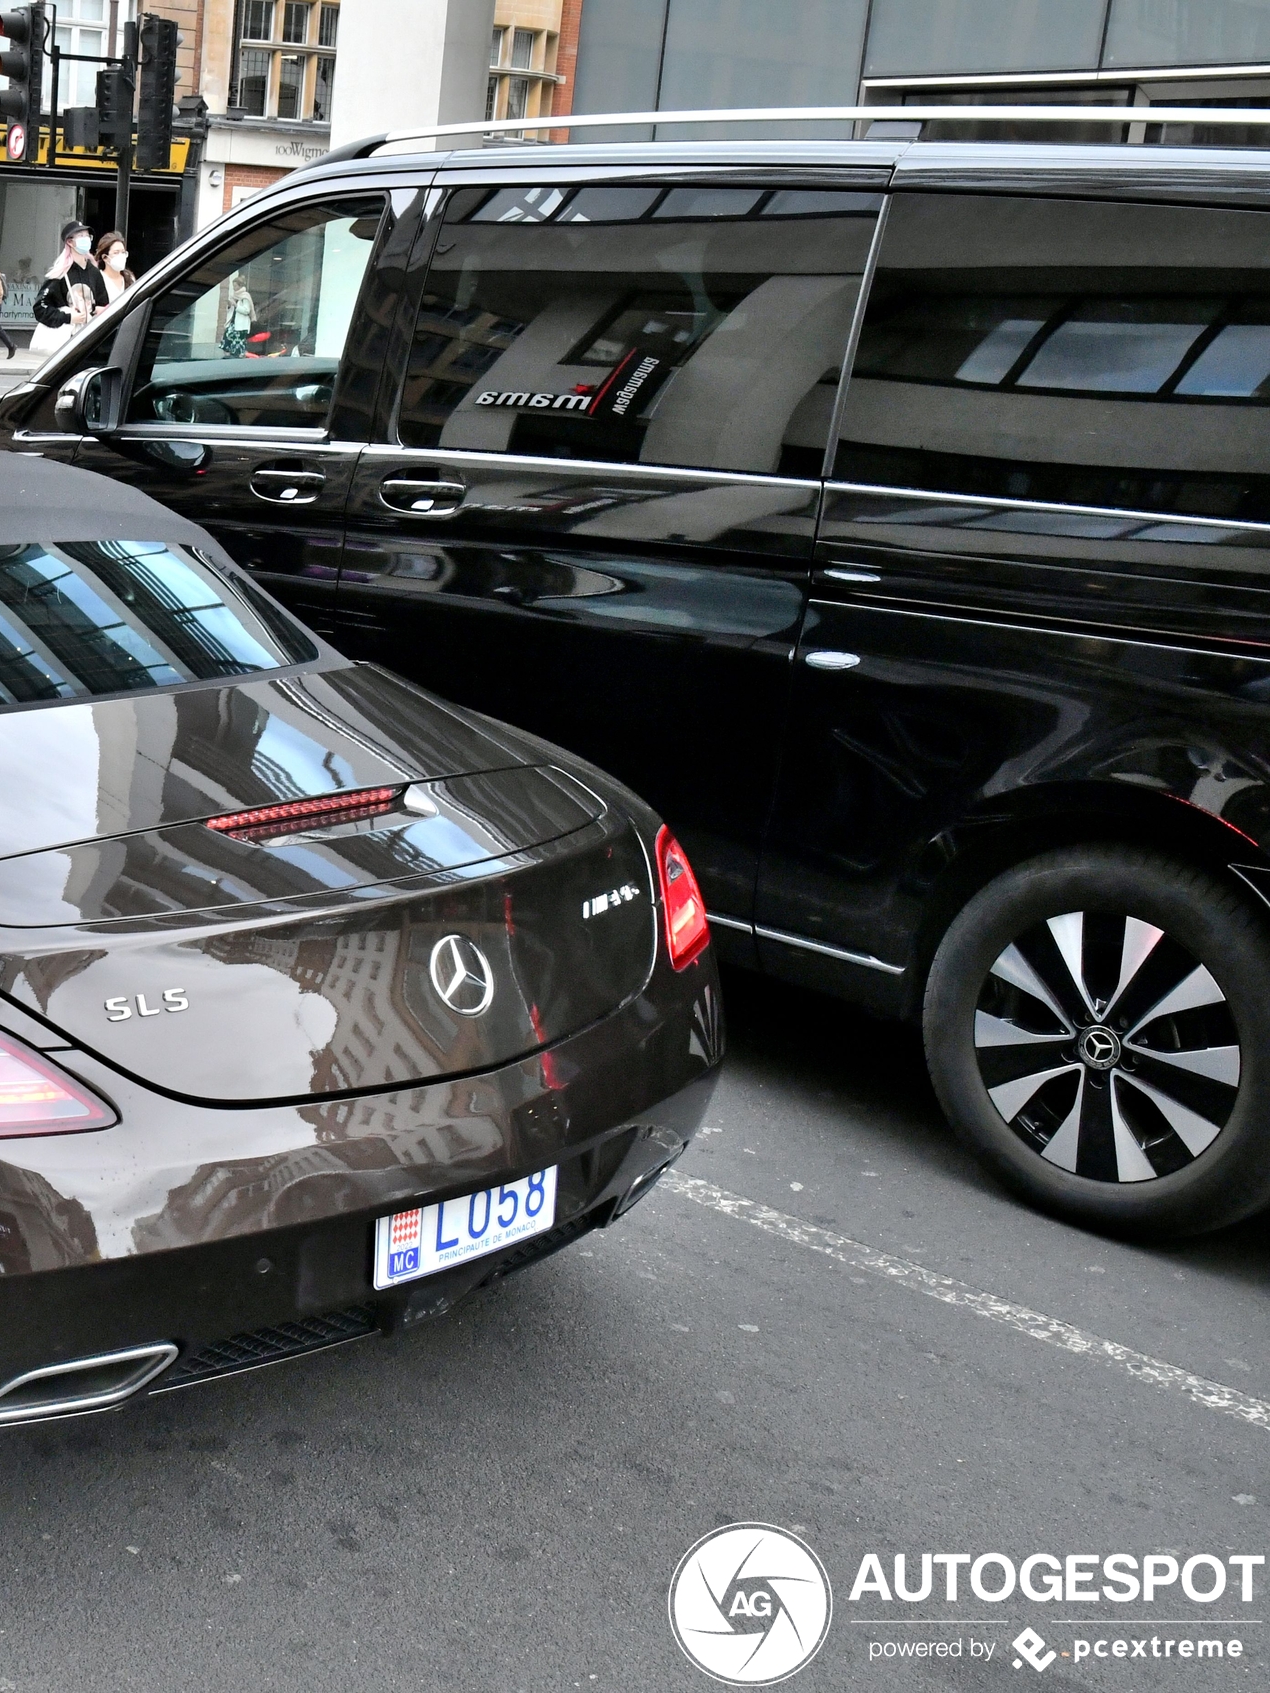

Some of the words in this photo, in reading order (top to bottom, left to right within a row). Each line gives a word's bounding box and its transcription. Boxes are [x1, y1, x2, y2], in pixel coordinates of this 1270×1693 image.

[275, 141, 329, 161] 100Wigmo
[104, 987, 189, 1022] SLS
[396, 1241, 414, 1252] 2022
[438, 1237, 490, 1263] PRINCIPAUTE
[492, 1233, 503, 1244] DE
[505, 1219, 537, 1240] MONACO
[393, 1250, 415, 1273] MC
